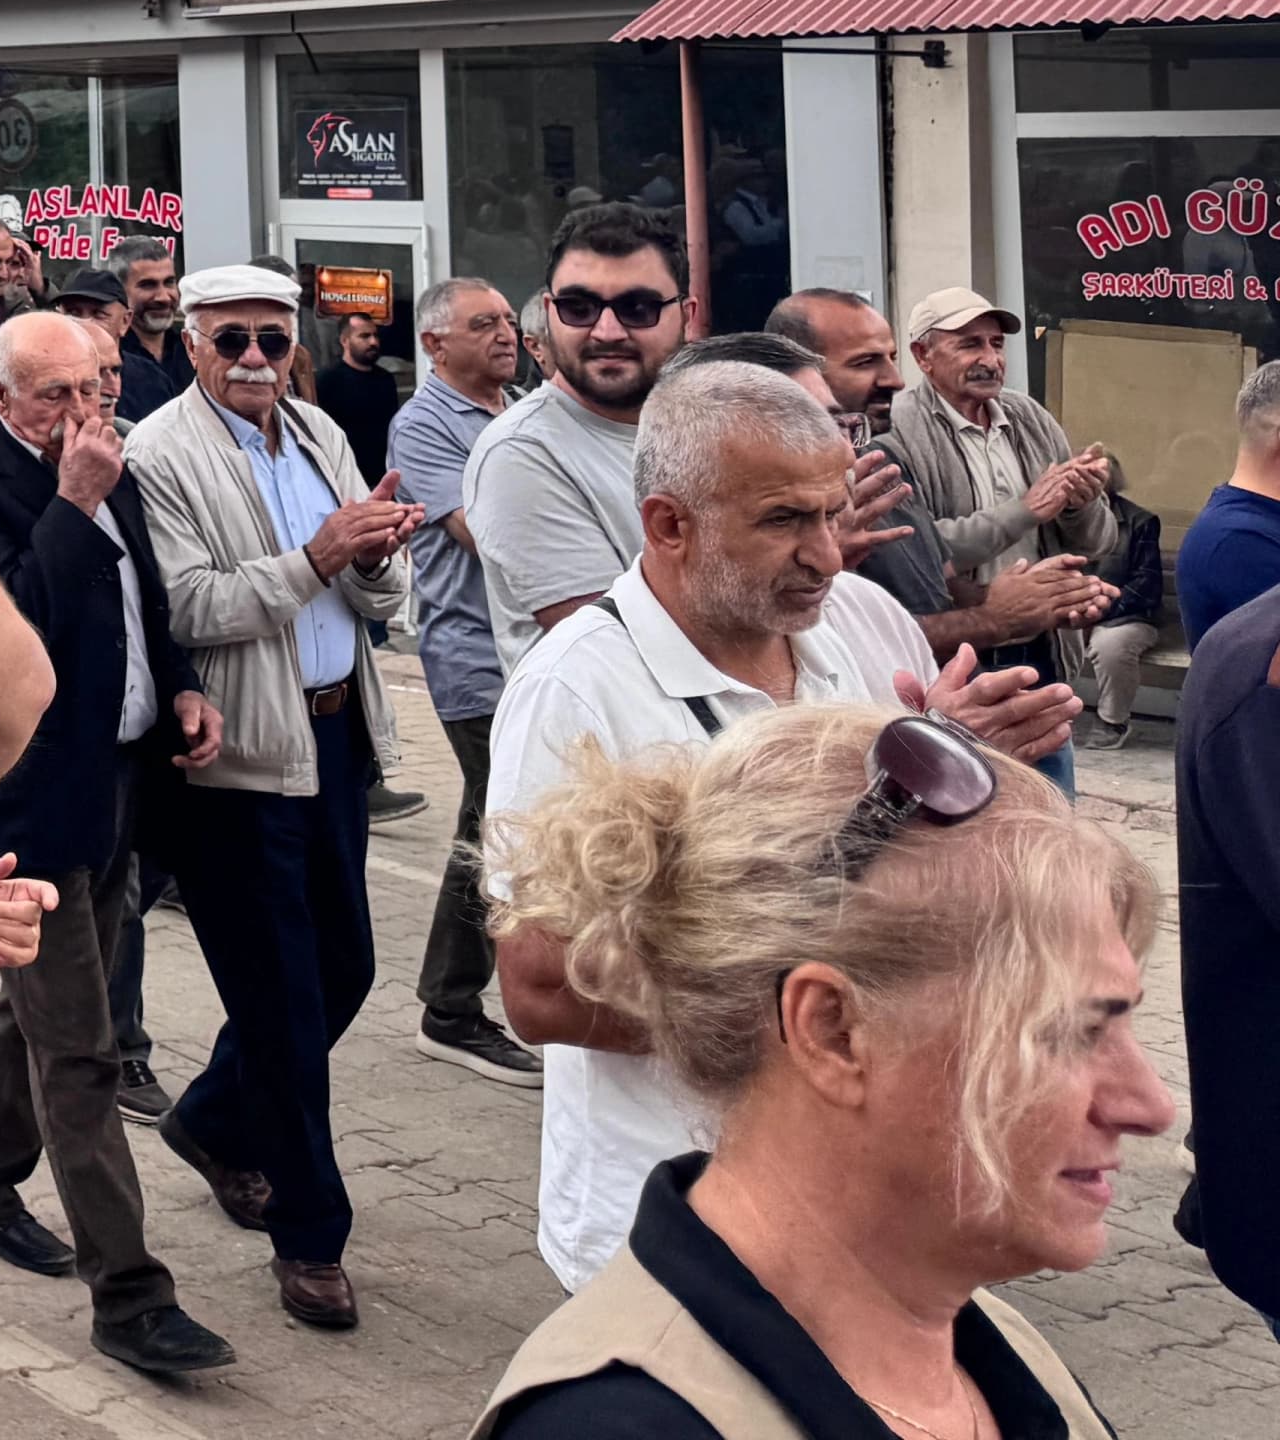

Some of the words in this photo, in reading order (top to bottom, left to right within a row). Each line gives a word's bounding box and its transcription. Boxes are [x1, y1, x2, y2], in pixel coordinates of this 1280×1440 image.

[329, 120, 395, 157] ASLAN
[24, 183, 182, 232] ASLANLAR
[34, 223, 92, 260] Pide
[1077, 194, 1171, 259] ADI
[1082, 267, 1235, 301] ŞARKÜTERİ
[1243, 275, 1268, 301] &
